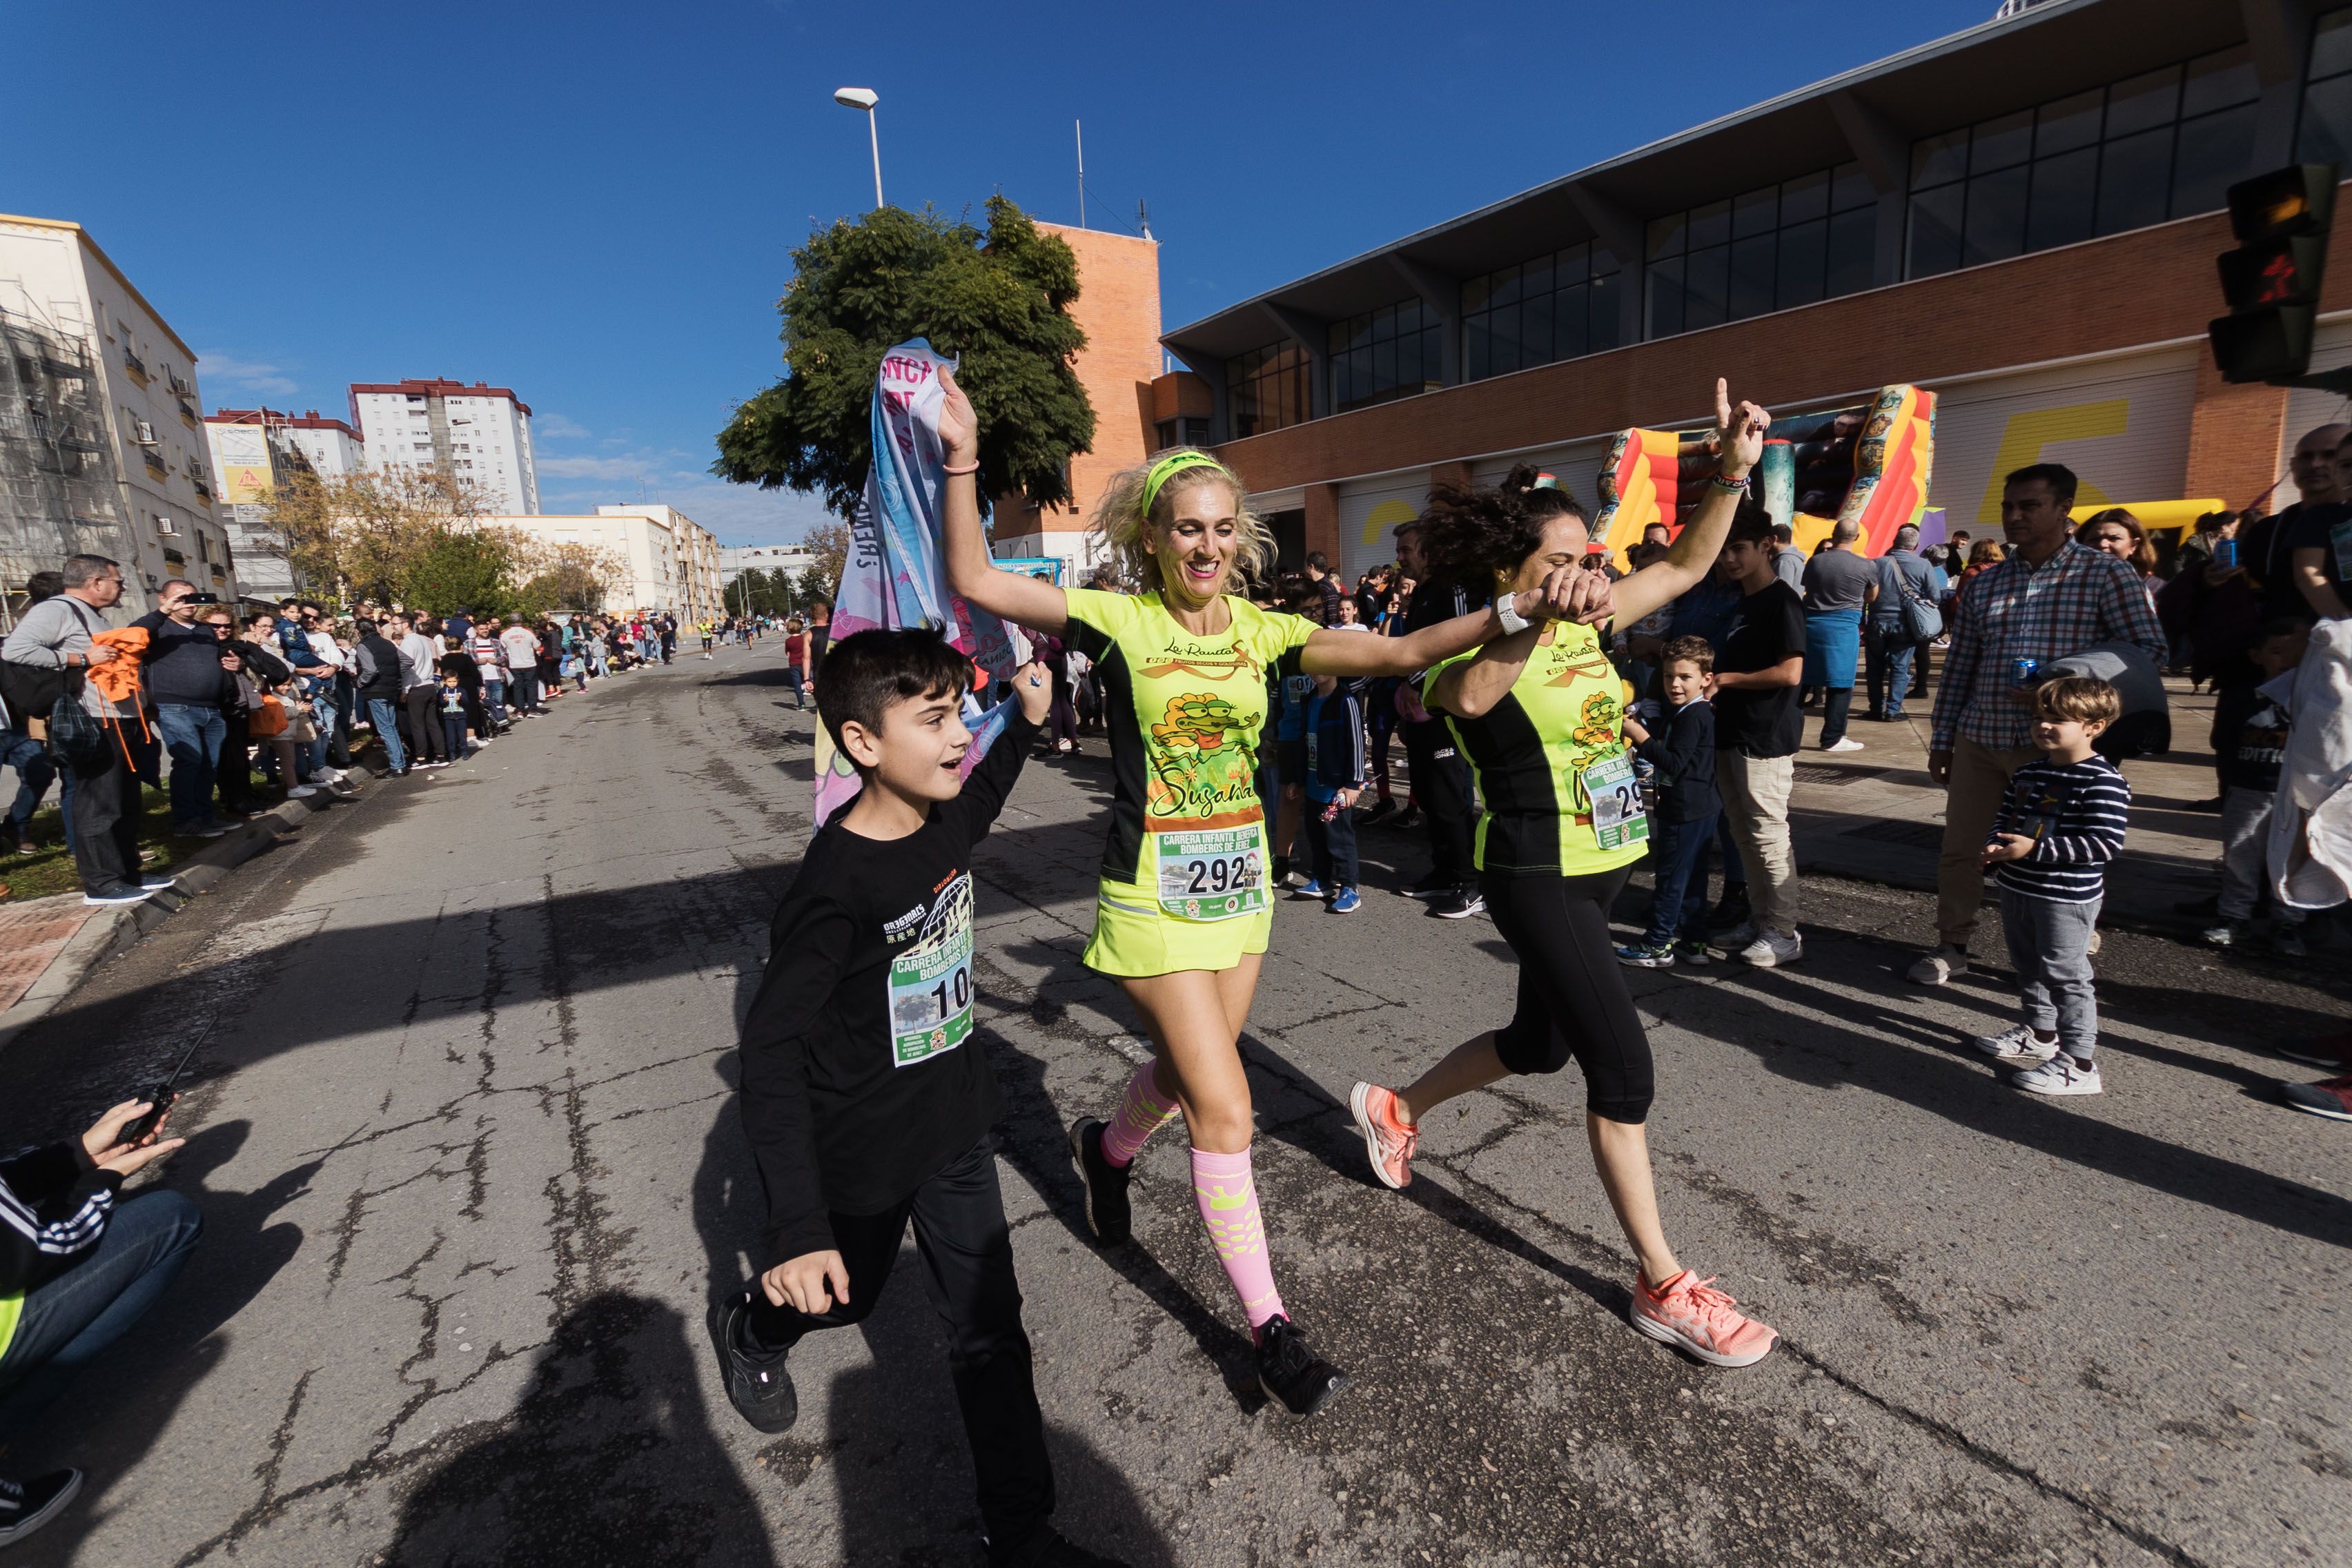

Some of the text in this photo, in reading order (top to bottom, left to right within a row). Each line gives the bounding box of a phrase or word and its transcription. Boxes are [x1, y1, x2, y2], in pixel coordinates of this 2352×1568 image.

[882, 356, 932, 385] NCA
[1164, 636, 1182, 655] La
[1152, 767, 1256, 818] Susana
[1164, 827, 1258, 845] CARRERA INFANTIL BENEFICA
[1181, 839, 1250, 854] BOMBEROS DE JEREZ
[1187, 856, 1245, 894] 292
[897, 949, 942, 973] CARRERA
[920, 948, 961, 981] BOMBEROS
[931, 959, 974, 1020] 10
